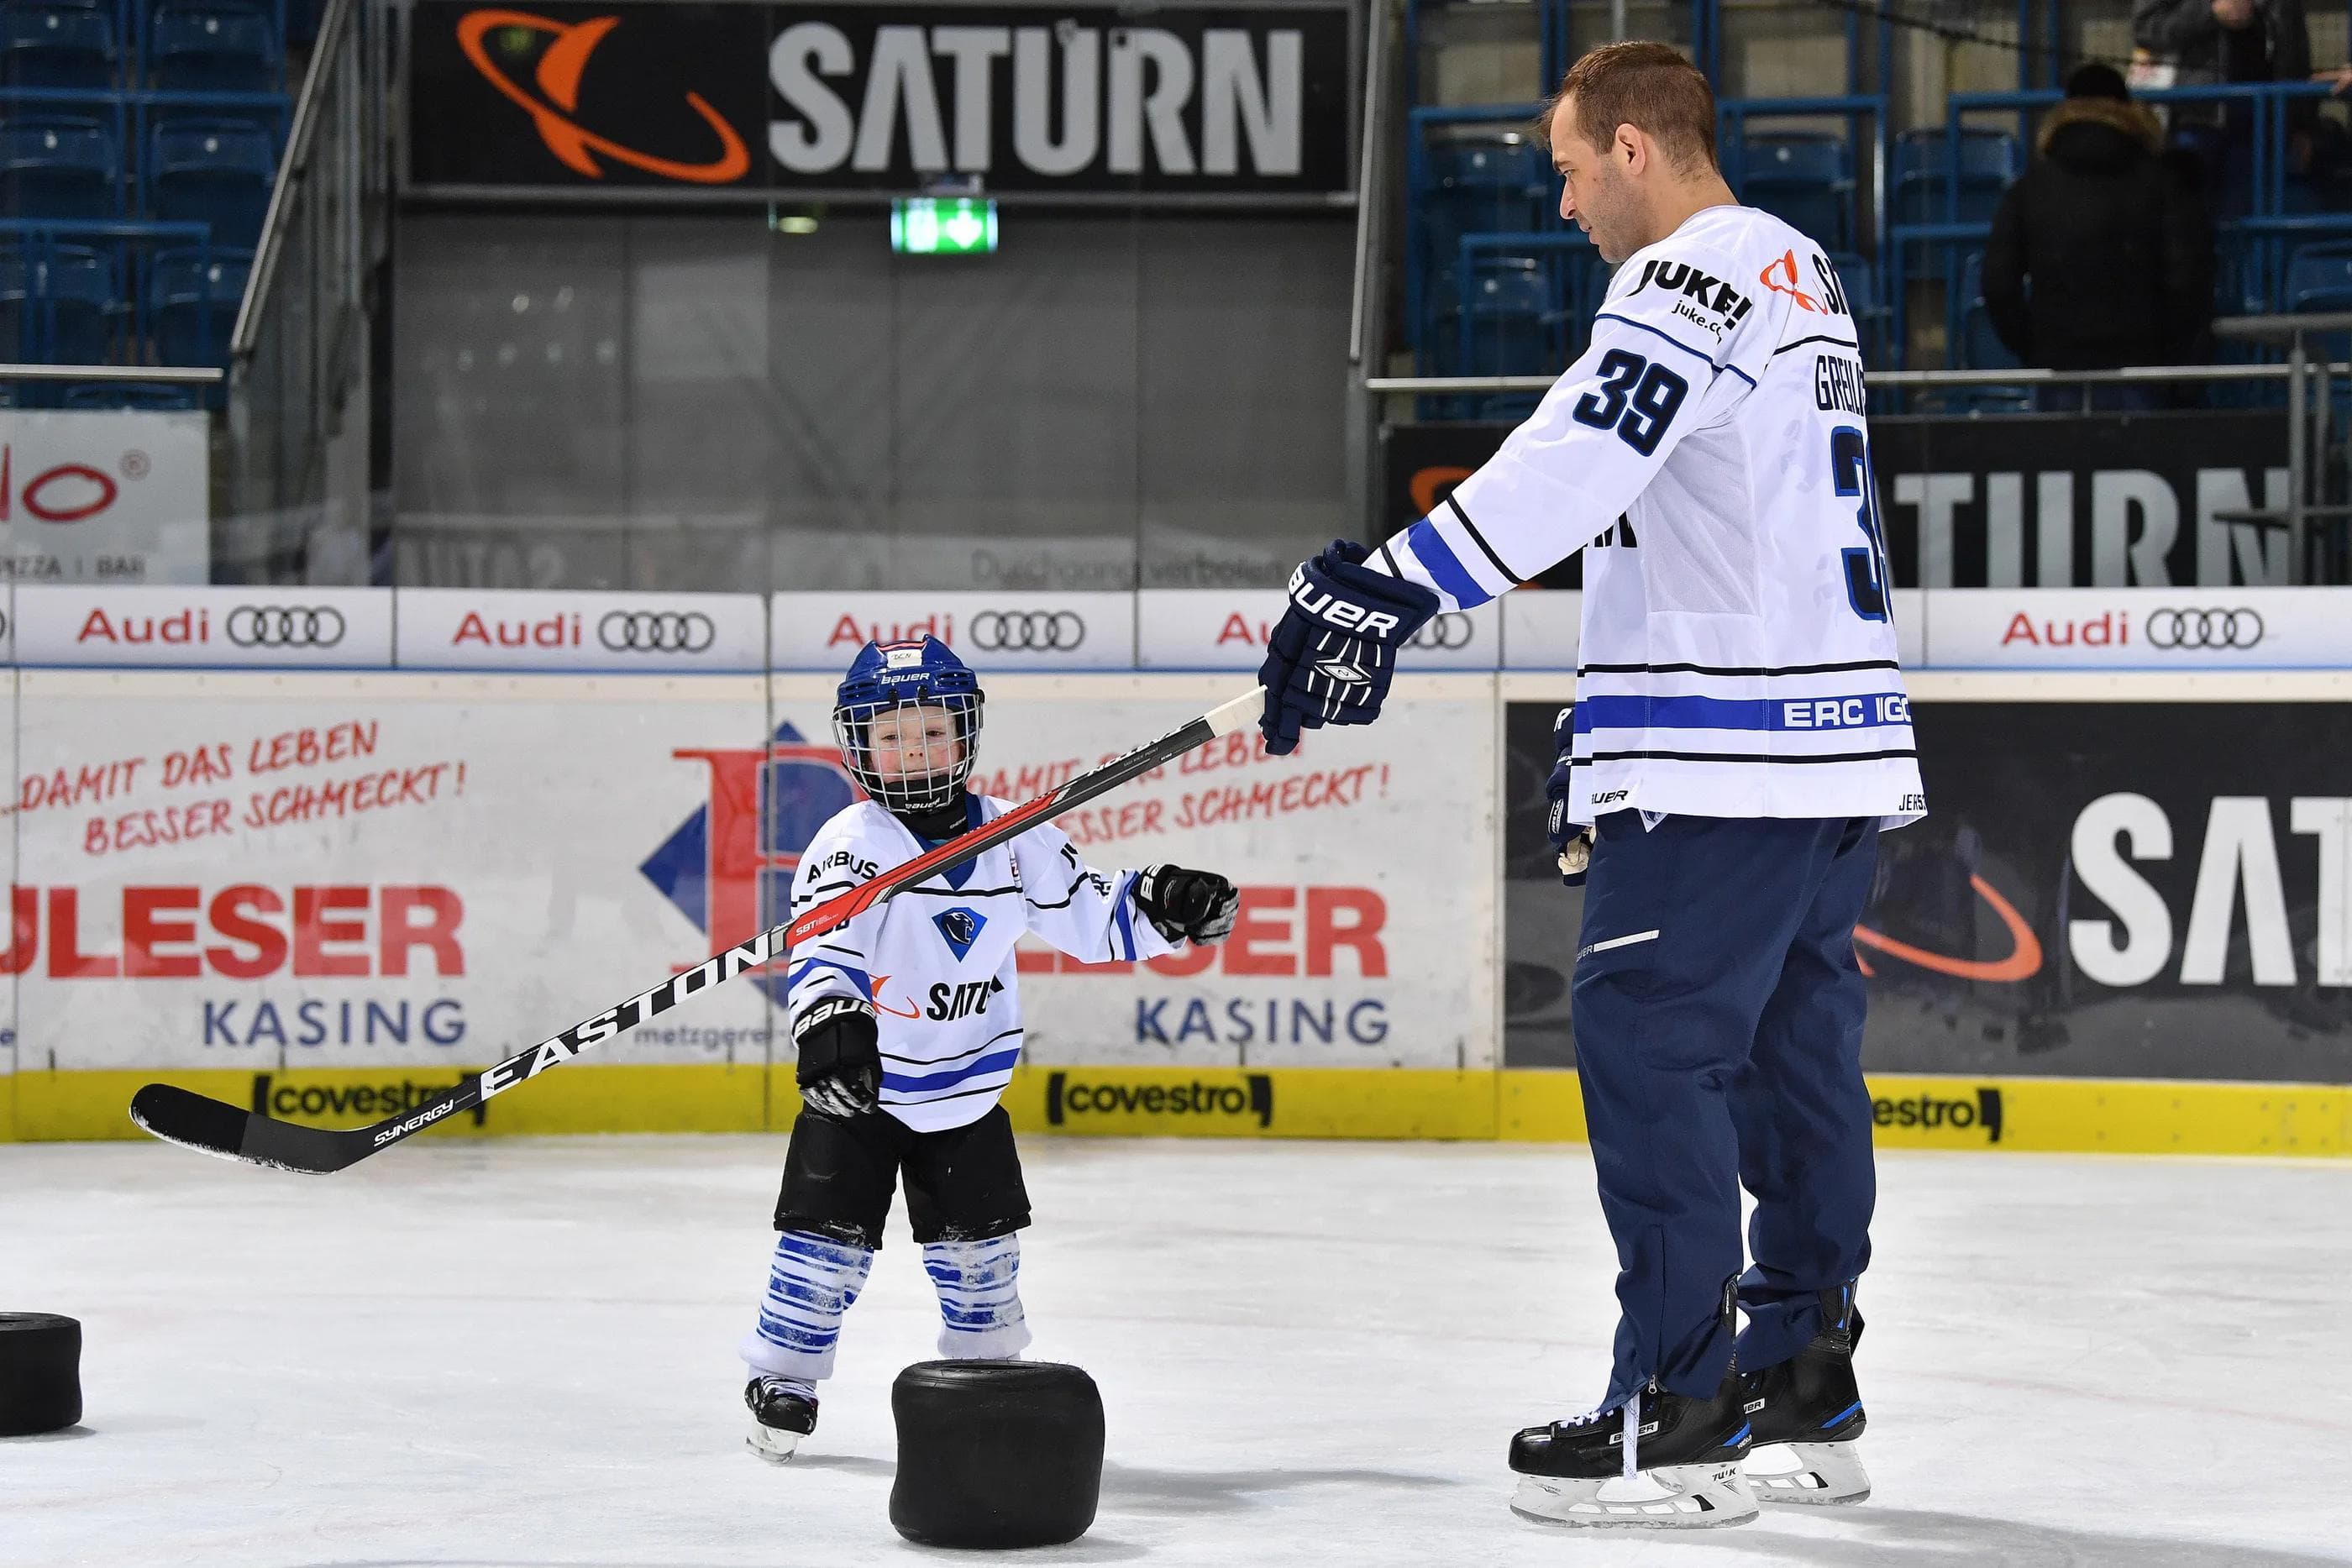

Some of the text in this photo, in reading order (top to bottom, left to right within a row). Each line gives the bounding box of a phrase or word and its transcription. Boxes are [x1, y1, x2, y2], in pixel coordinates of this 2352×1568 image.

[768, 20, 1304, 176] SATURN
[1572, 348, 1689, 458] 39
[1830, 425, 1895, 629] 3
[1877, 467, 2289, 588] TURN
[77, 608, 210, 643] Audi
[452, 611, 582, 648] Audi
[2002, 611, 2129, 647] Audi
[1783, 699, 1864, 727] ERC
[19, 719, 379, 811] DAMIT DAS LEBEN
[84, 761, 467, 855] BESSER SCHMECKT!
[1055, 800, 1165, 844] ESSER
[1174, 762, 1390, 828] SCHMECKT!
[807, 851, 879, 884] AIRBUS
[203, 999, 466, 1047] KASING
[480, 931, 769, 1102] EASTON
[1136, 998, 1390, 1045] KASING
[374, 1099, 454, 1147] SYNERGY
